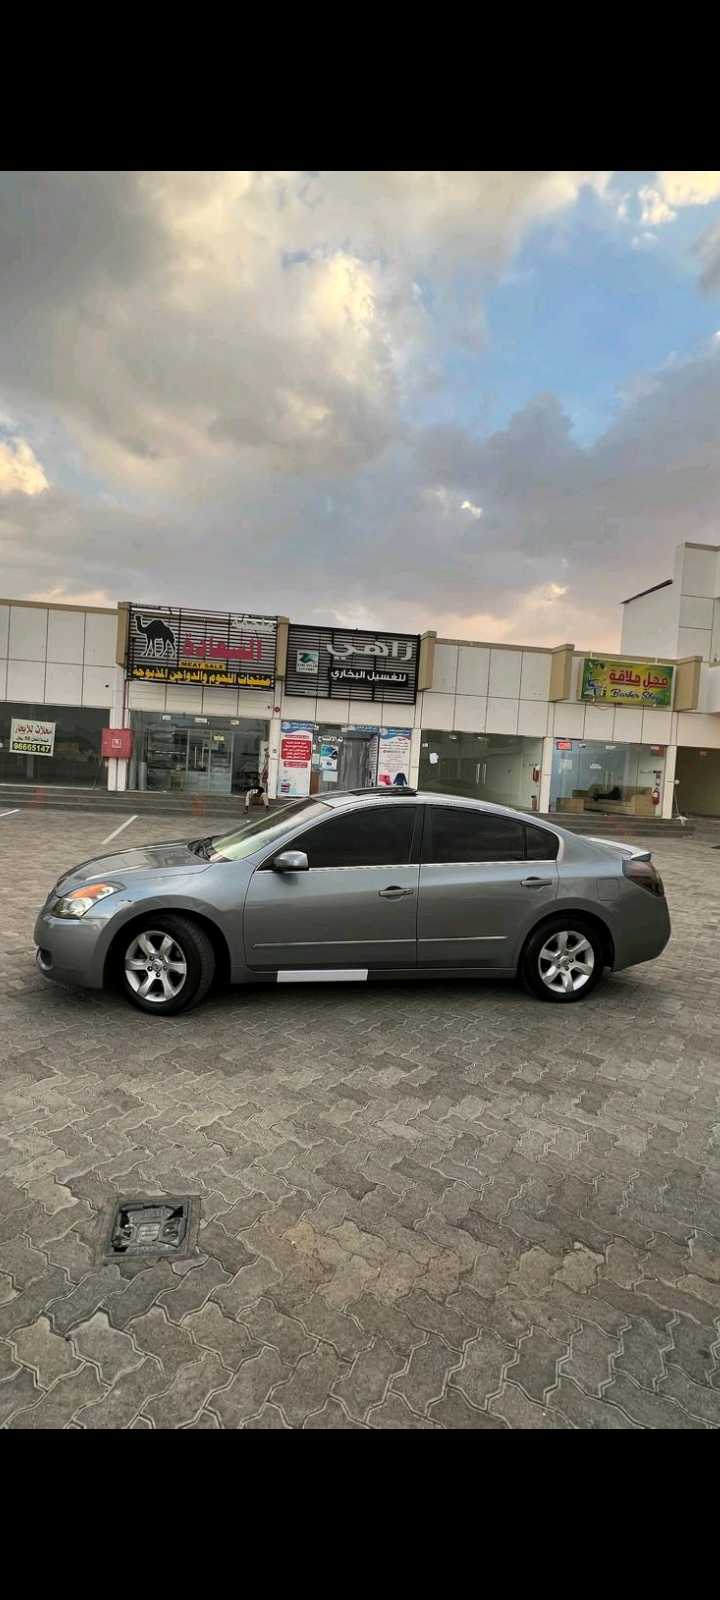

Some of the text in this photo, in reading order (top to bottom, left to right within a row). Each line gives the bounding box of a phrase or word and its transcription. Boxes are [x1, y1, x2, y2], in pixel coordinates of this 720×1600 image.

[326, 639, 413, 661] زاهي
[330, 669, 406, 682] للغسيل البخاري
[608, 669, 668, 687] محل حلاقة
